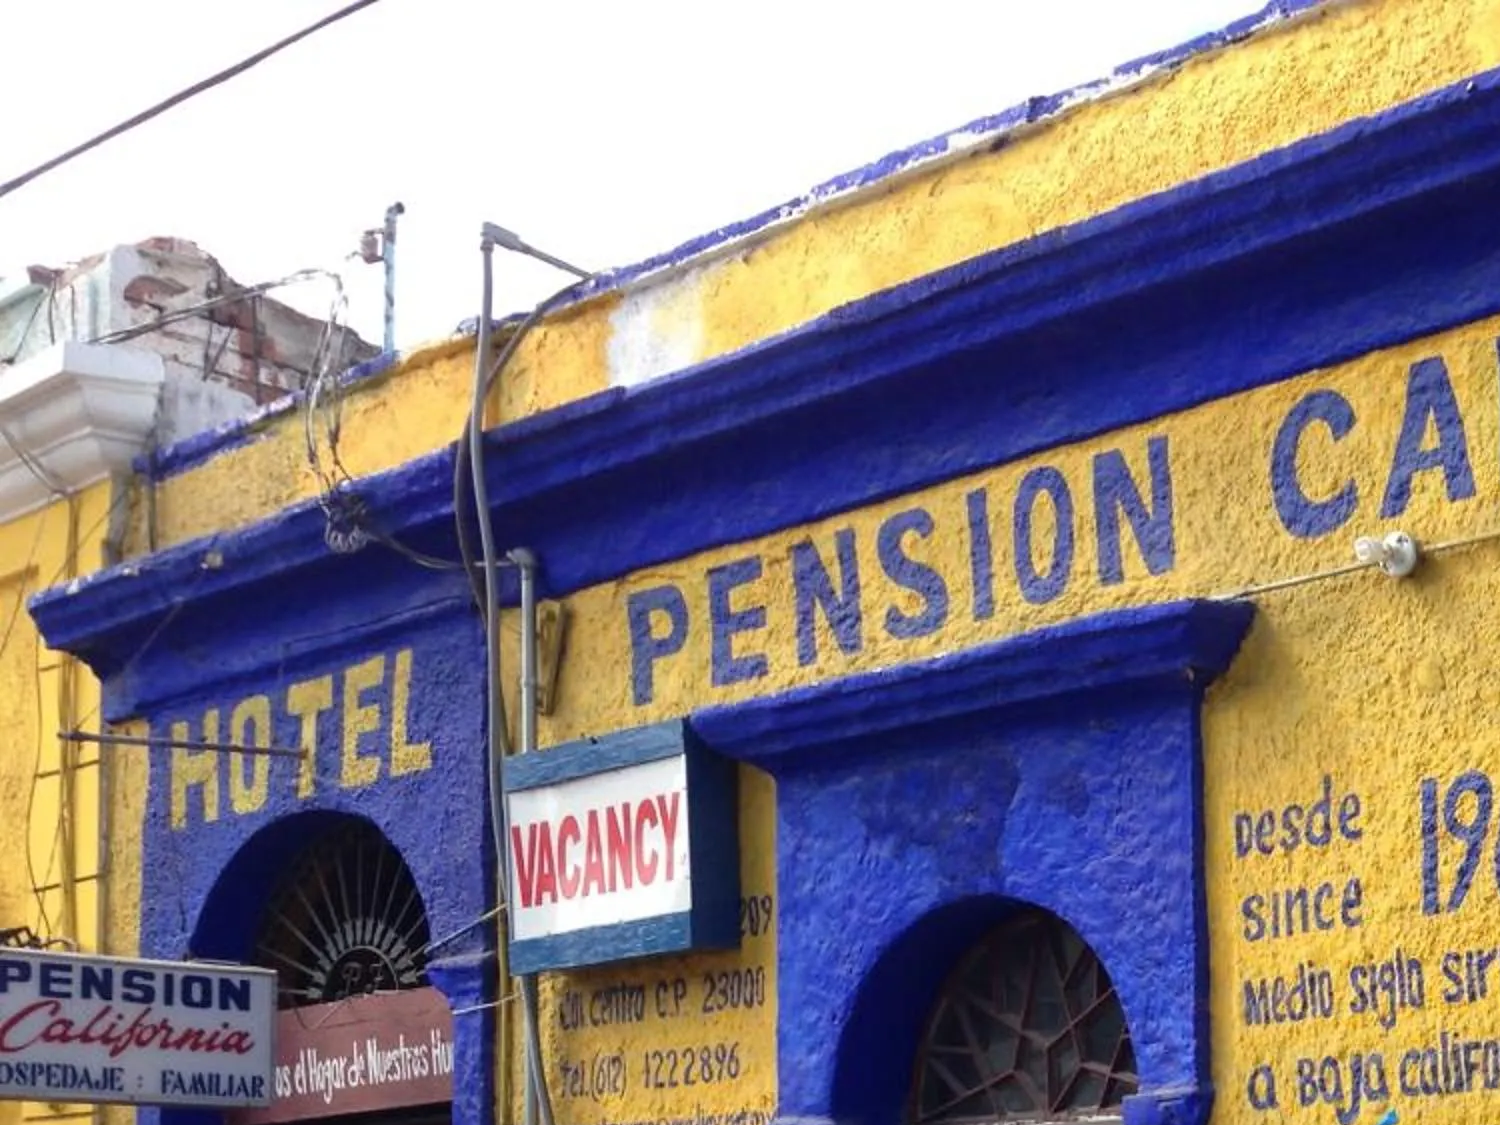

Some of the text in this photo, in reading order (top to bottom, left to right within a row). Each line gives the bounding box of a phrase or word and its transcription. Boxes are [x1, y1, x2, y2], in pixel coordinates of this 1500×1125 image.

[626, 435, 1177, 706] PENSION
[170, 648, 432, 832] HOTEL
[511, 791, 680, 909] VACANCY
[1233, 774, 1363, 858] Desde
[1241, 876, 1363, 942] since
[0, 959, 252, 1012] PENSION
[702, 965, 766, 1014] 23000
[1243, 959, 1334, 1026] Medio
[1350, 945, 1425, 1030] siglo
[0, 1000, 254, 1058] California
[160, 1069, 265, 1099] FAMILIAR
[307, 1048, 348, 1104] Hogar
[347, 1040, 365, 1086] de
[431, 1027, 455, 1076] Hu
[1247, 1062, 1279, 1112] a
